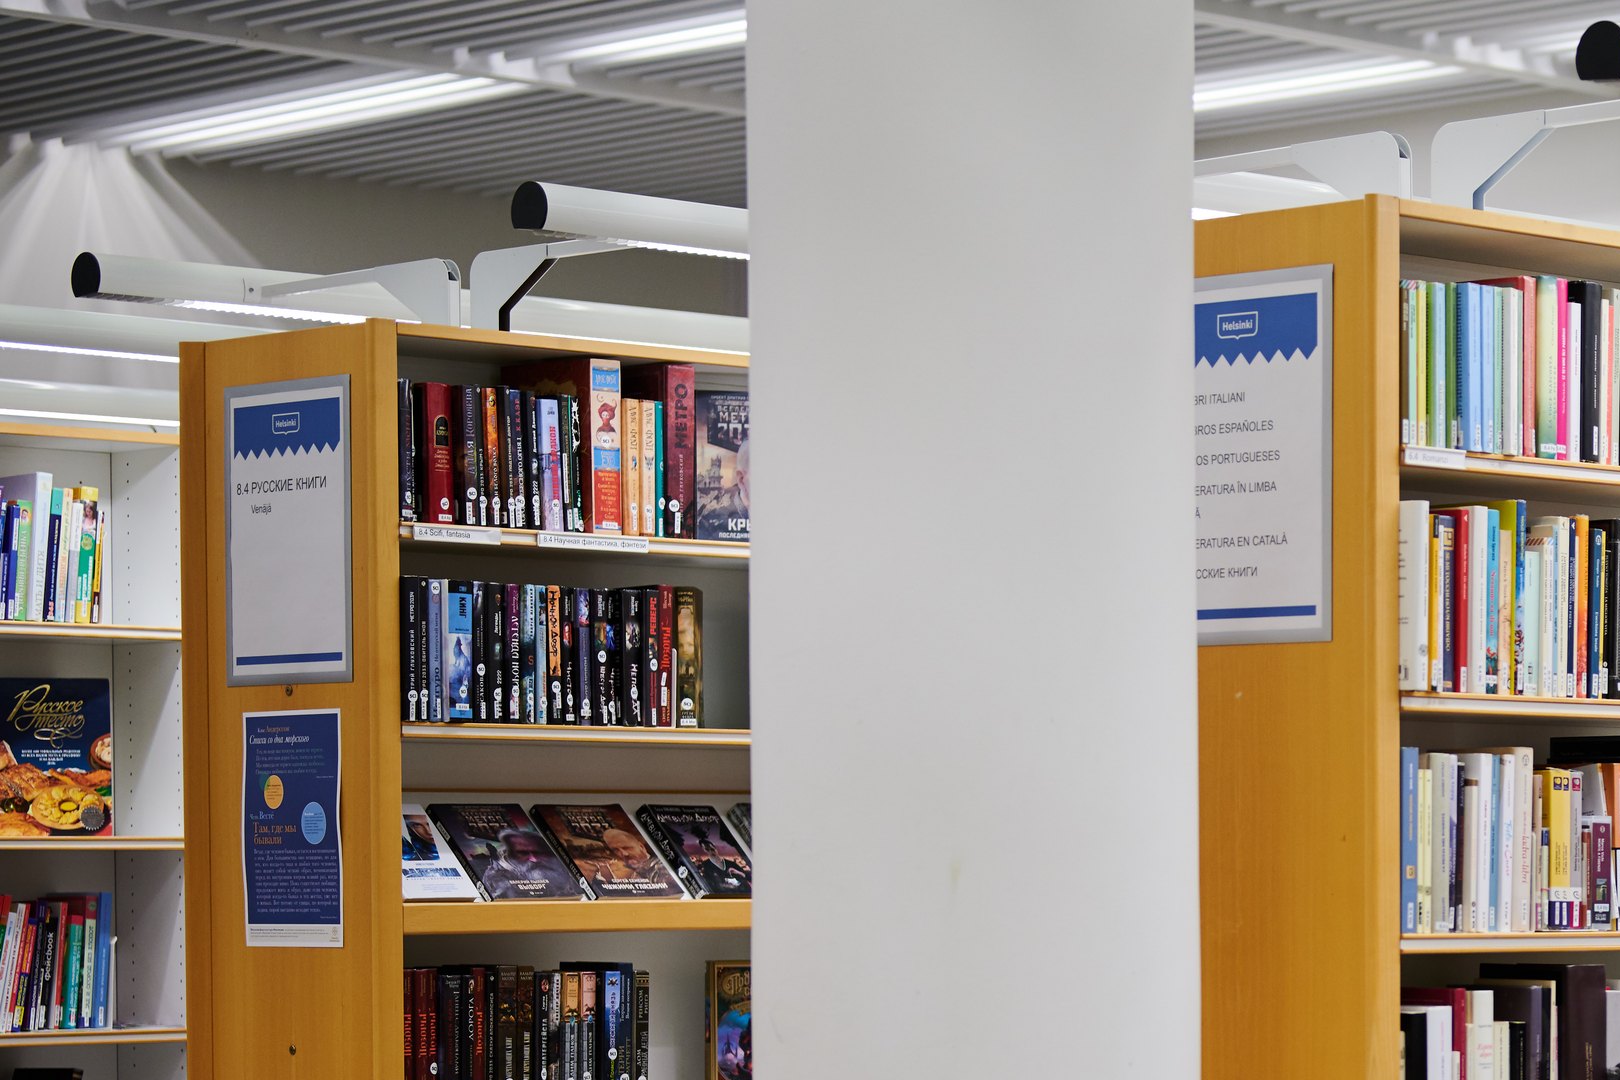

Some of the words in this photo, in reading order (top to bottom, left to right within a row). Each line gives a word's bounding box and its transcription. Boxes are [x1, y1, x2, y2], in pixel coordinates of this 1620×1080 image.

[1222, 319, 1253, 331] Helsinki
[1209, 392, 1245, 404] ITALIANI
[275, 418, 297, 428] Helsinki
[674, 383, 688, 449] МЕТРО
[1219, 419, 1274, 434] ESPAÑOLES
[1211, 449, 1280, 465] PORTUGUESES
[236, 483, 249, 496] 8.4
[251, 478, 293, 494] РУССКИЕ
[295, 475, 327, 490] КНИГИ
[1237, 480, 1246, 494] ÎN
[1249, 480, 1277, 493] LIMBA
[251, 503, 272, 515] Venäjä
[446, 530, 471, 539] fantasia
[1237, 536, 1250, 547] EN
[1252, 531, 1288, 546] CATALÀ
[553, 536, 581, 545] Научная
[581, 538, 620, 548] фантастика,
[1228, 566, 1258, 578] КНИГИ
[459, 596, 467, 618] КИНГ
[7, 683, 84, 722] Русское
